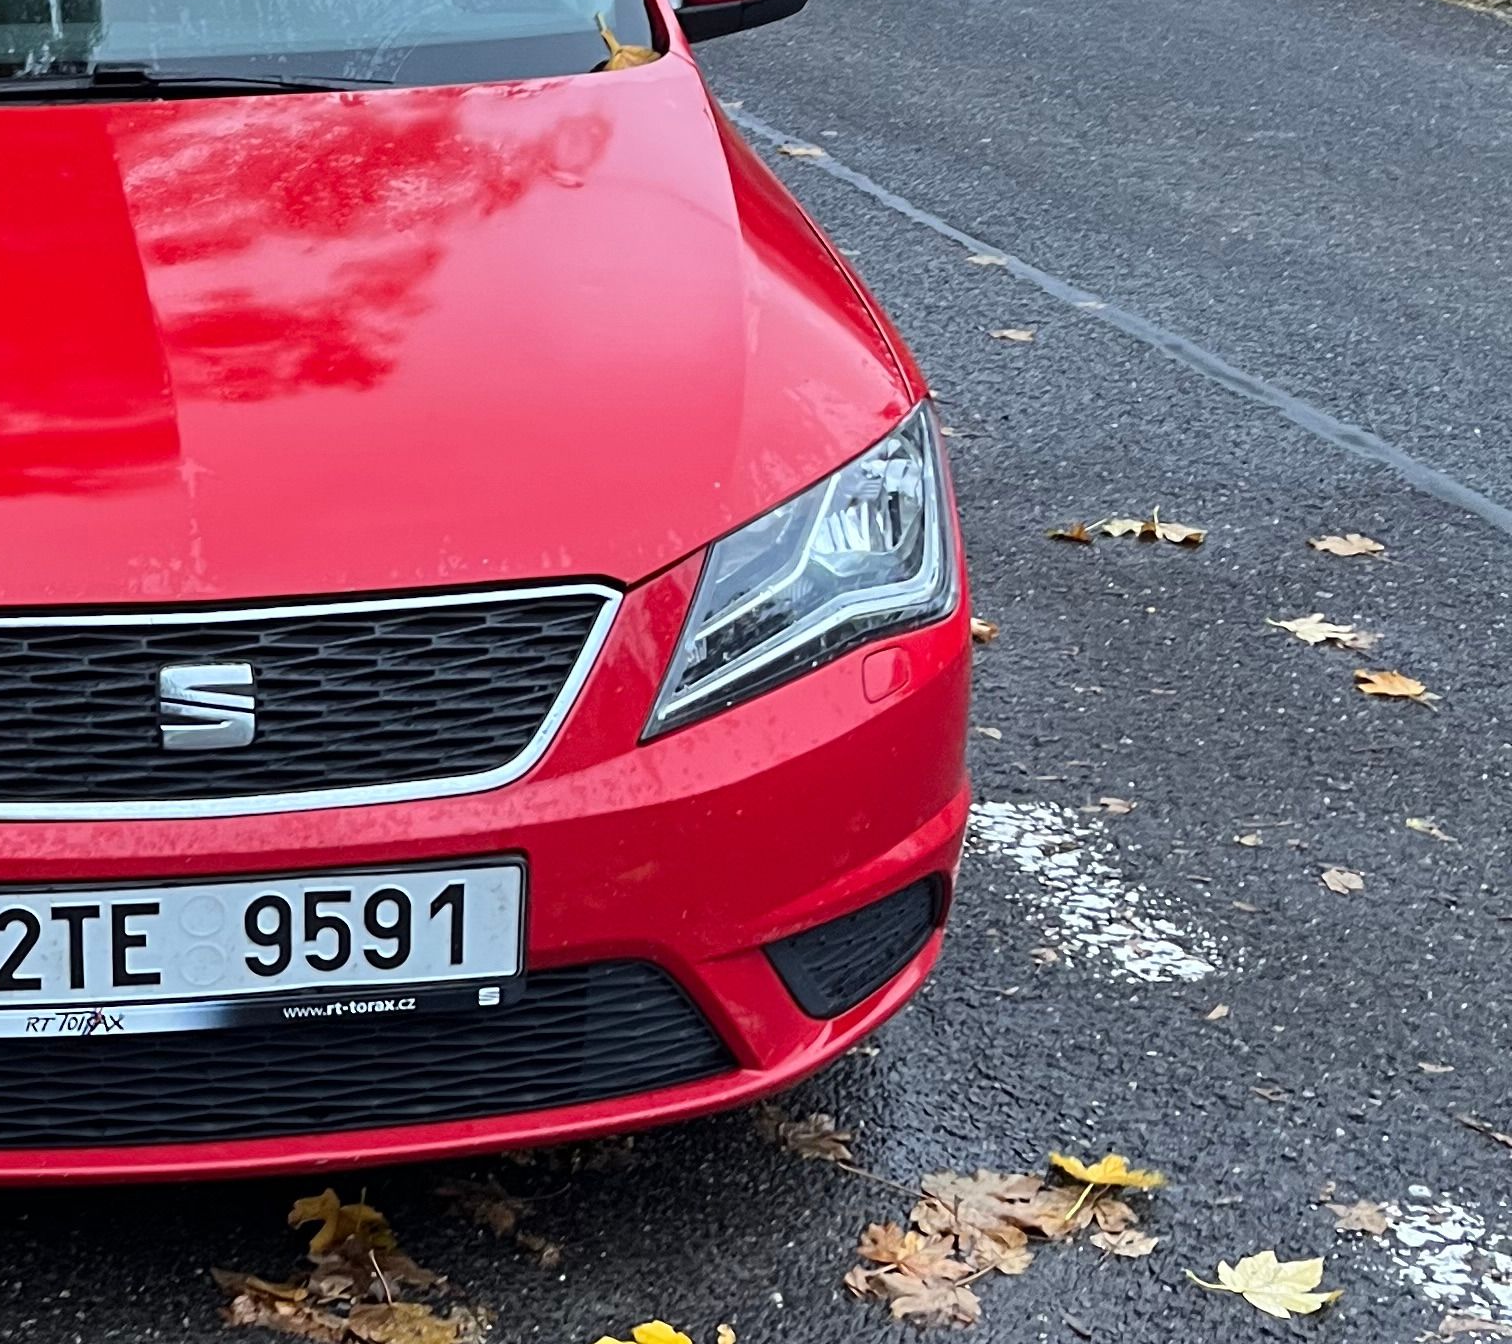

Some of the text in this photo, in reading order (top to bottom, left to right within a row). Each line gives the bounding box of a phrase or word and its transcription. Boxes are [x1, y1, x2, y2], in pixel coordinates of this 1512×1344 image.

[244, 882, 466, 977] 9591
[283, 997, 416, 1019] www.rt-torax.cz
[25, 1016, 55, 1033] RT
